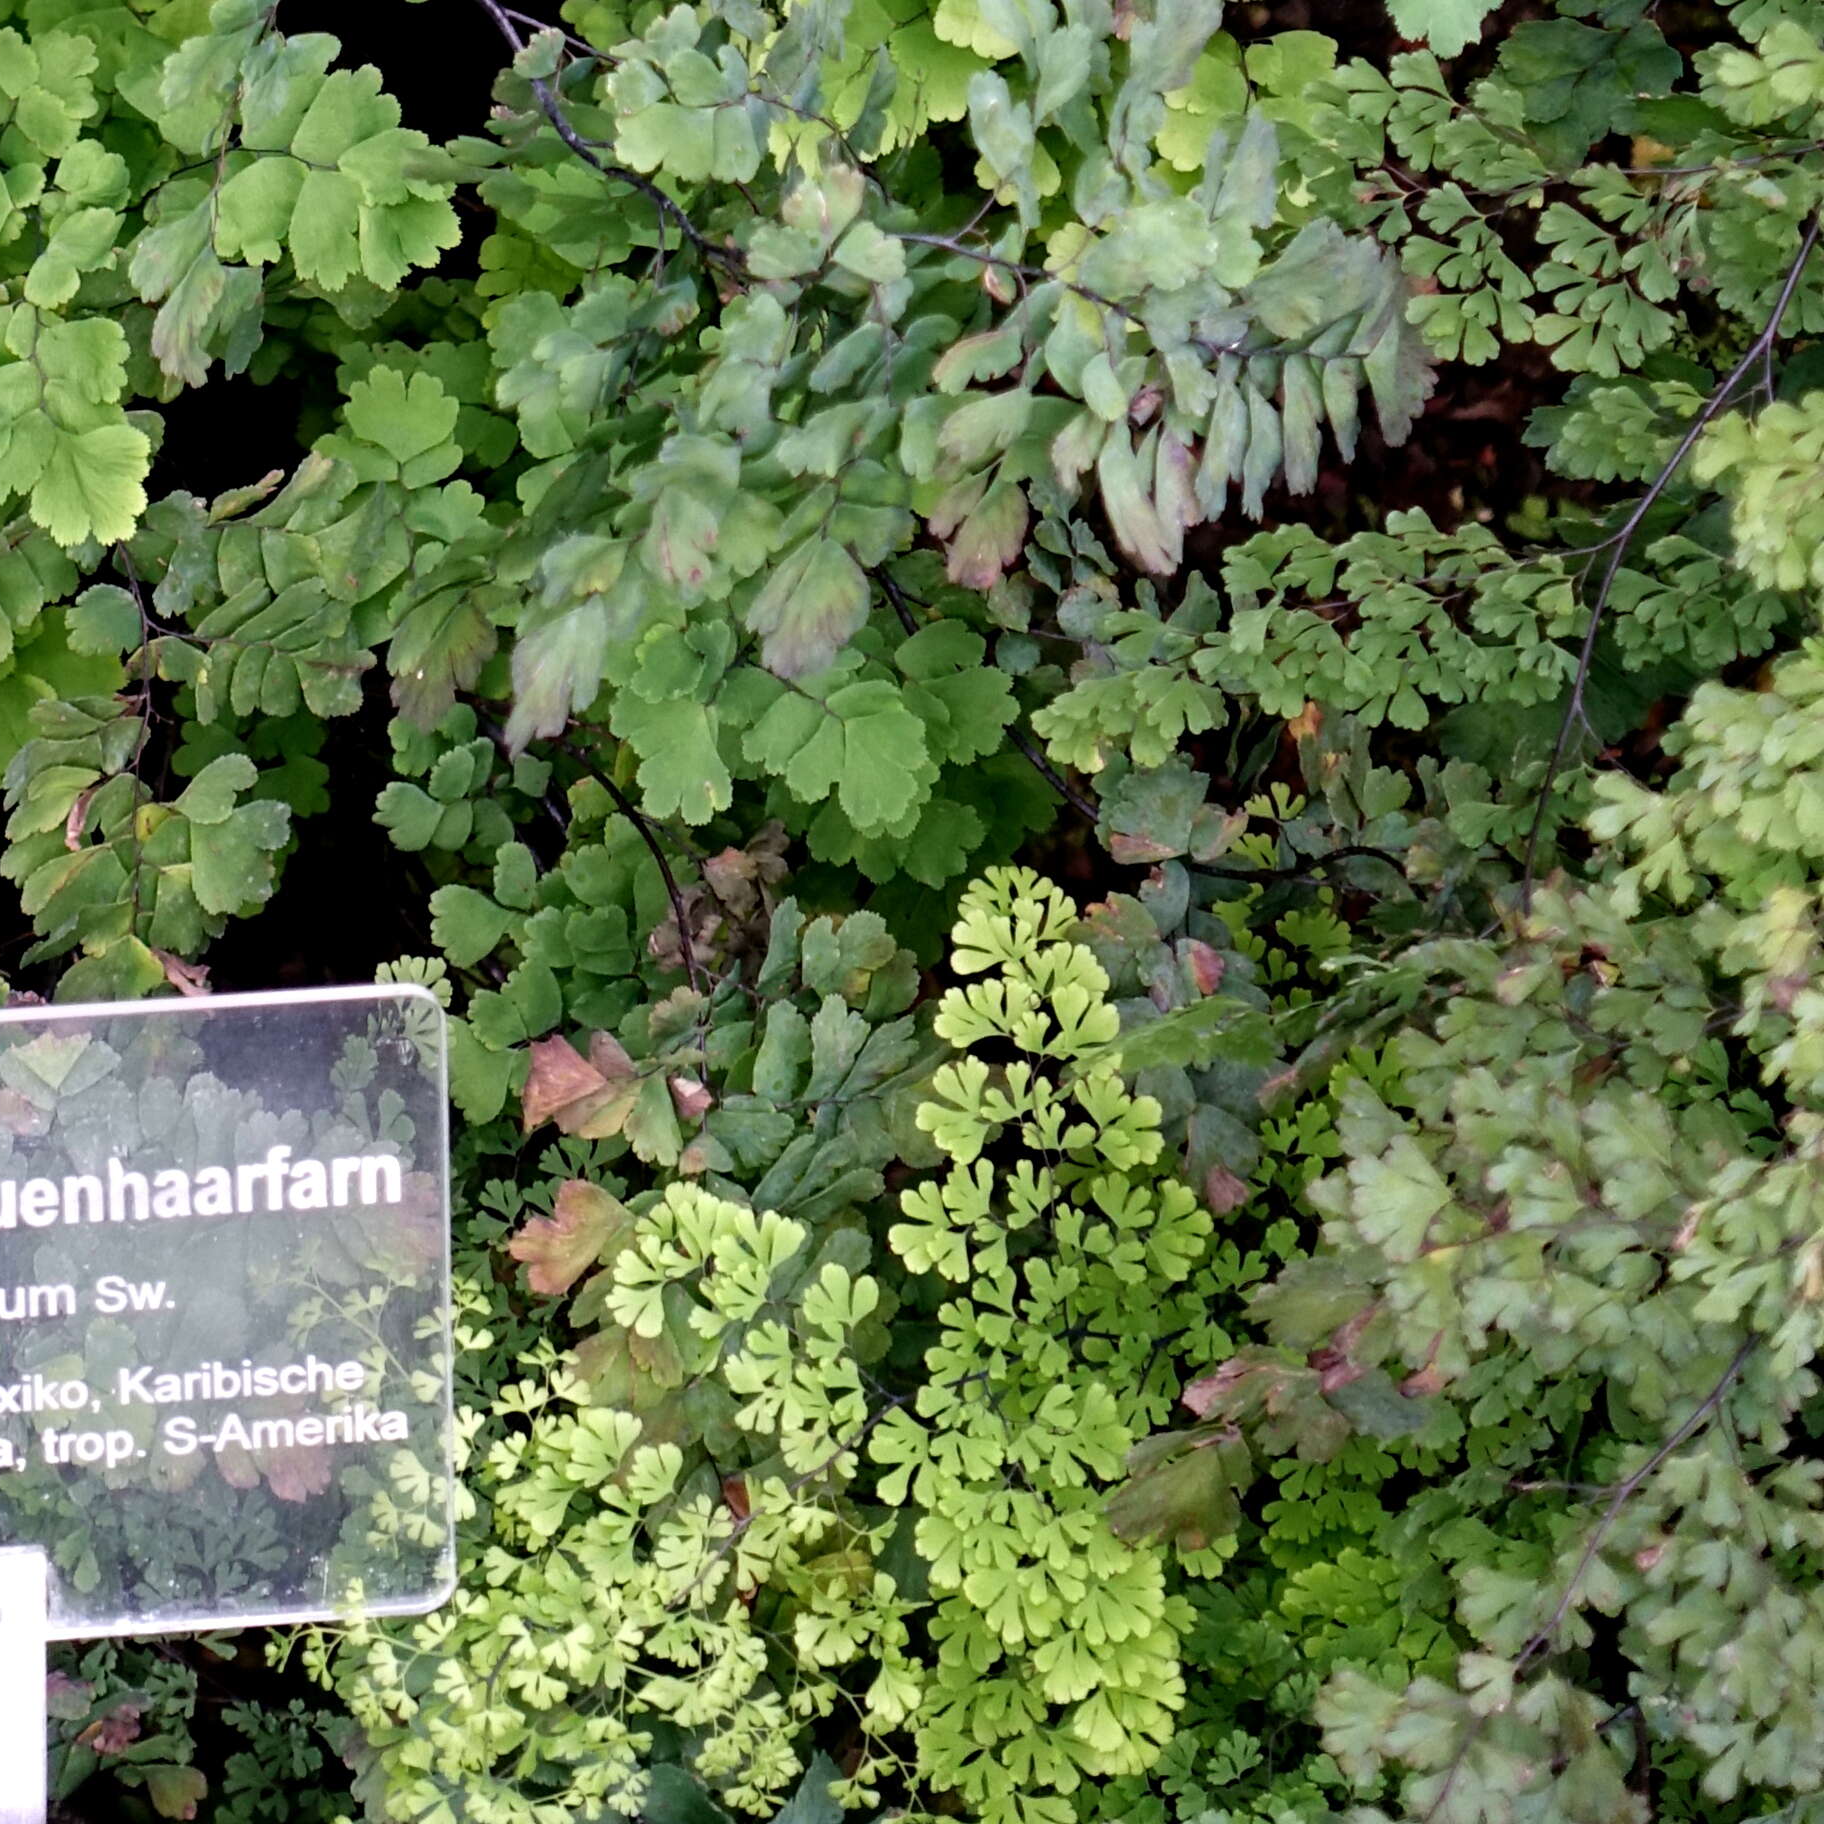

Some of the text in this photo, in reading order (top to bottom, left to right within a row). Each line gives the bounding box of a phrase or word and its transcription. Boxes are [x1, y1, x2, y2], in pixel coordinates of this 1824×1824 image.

[95, 1275, 176, 1315] Sw.
[120, 1355, 364, 1407] Karibische
[43, 1425, 145, 1469] trop.
[163, 1406, 407, 1457] S-Amerika
